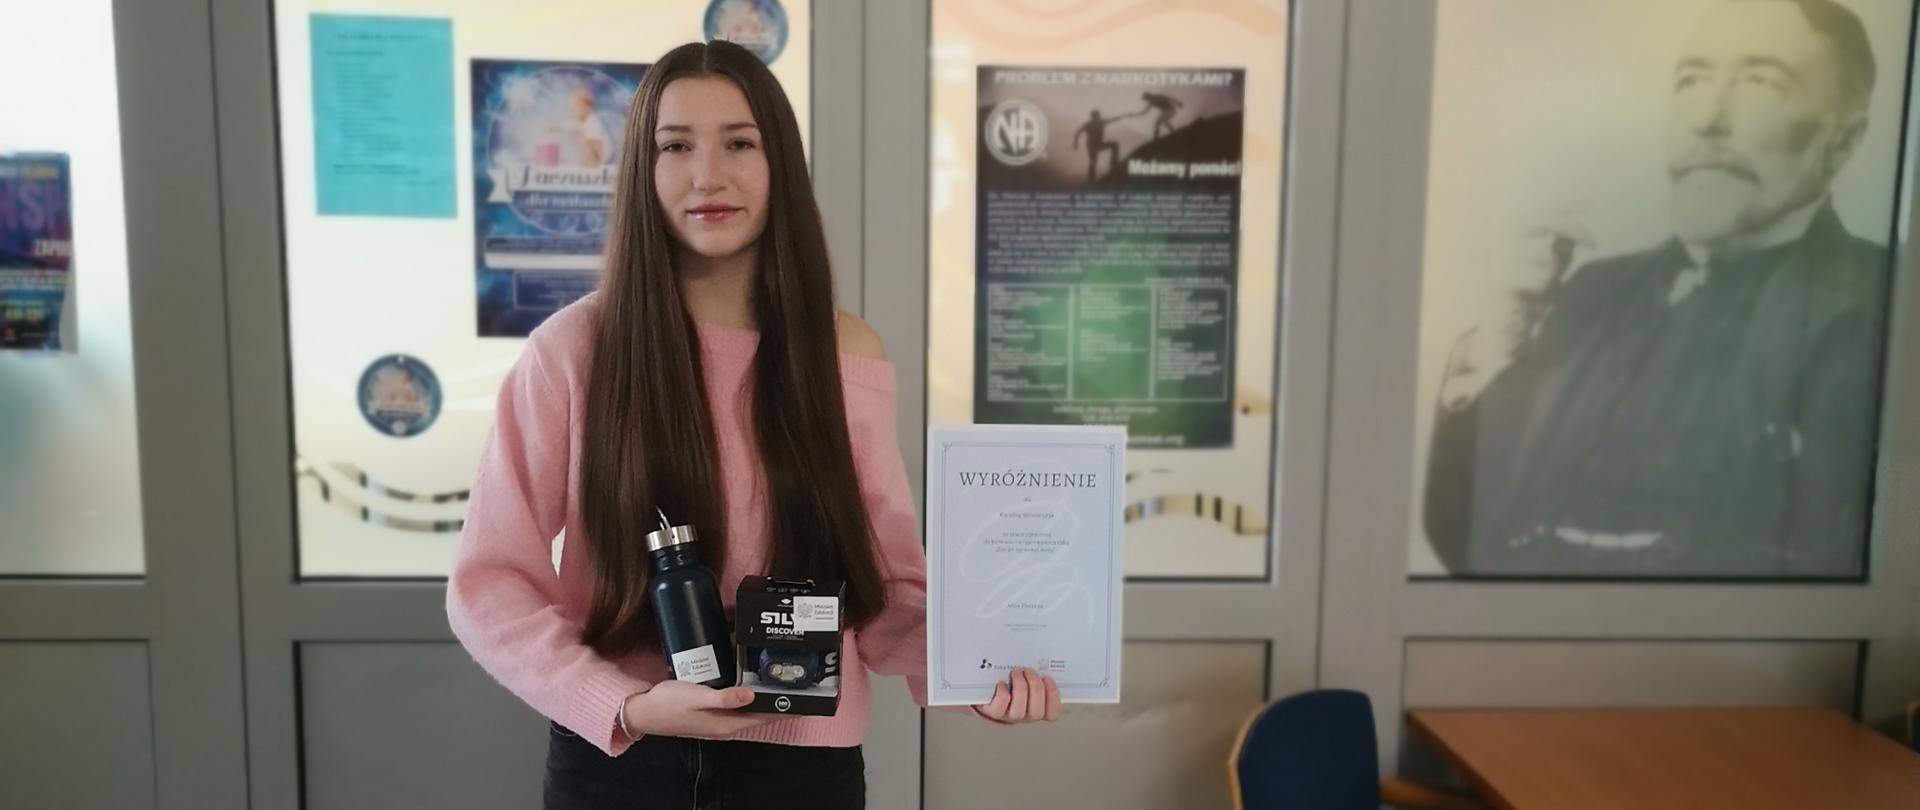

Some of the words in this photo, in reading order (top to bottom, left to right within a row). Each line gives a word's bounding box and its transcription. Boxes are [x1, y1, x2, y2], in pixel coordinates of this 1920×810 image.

[995, 71, 1075, 85] PROBLEM
[1079, 72, 1089, 85] Z
[1095, 72, 1233, 87] NARKOTYKAMI?
[959, 469, 1097, 488] WYRÓŻNIENIE
